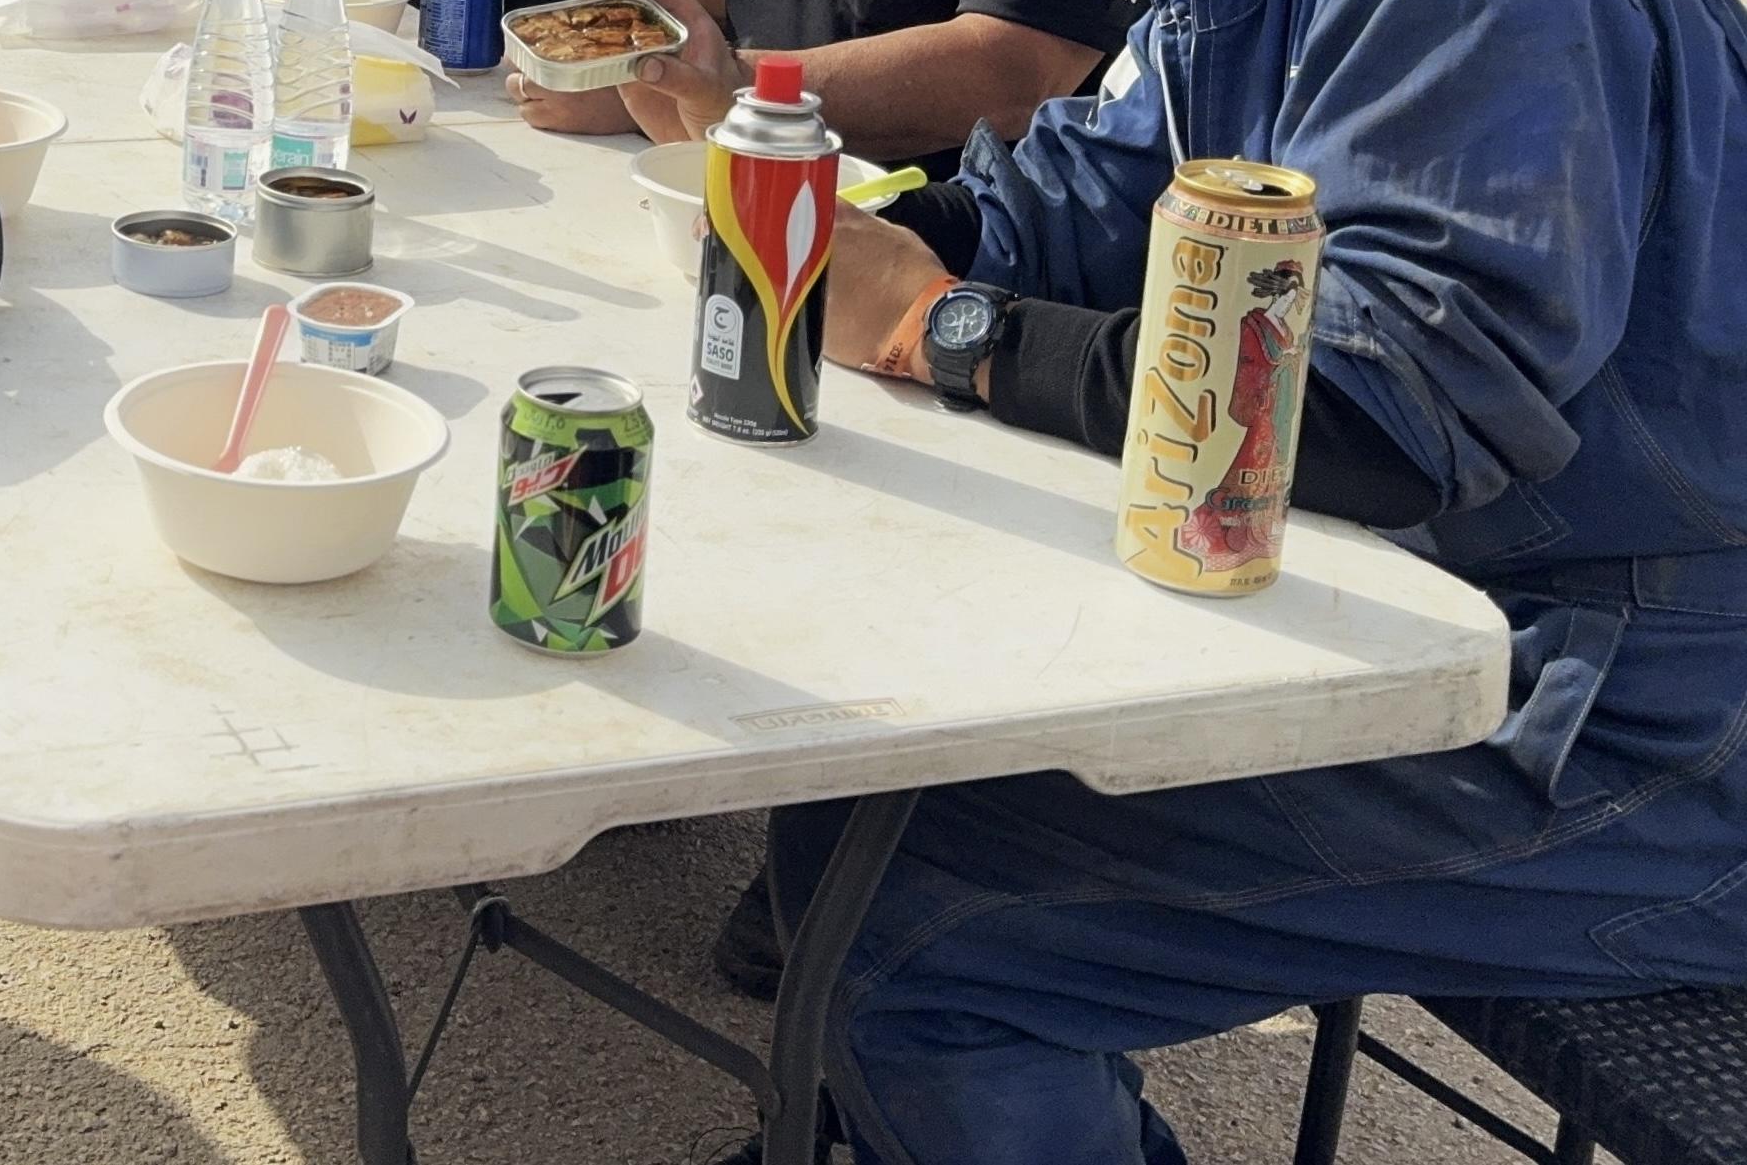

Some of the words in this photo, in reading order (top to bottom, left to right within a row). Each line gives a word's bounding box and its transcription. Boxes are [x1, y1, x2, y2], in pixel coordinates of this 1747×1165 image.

[1209, 213, 1272, 234] DIET
[707, 342, 734, 362] SASO
[1125, 236, 1227, 578] AriZona
